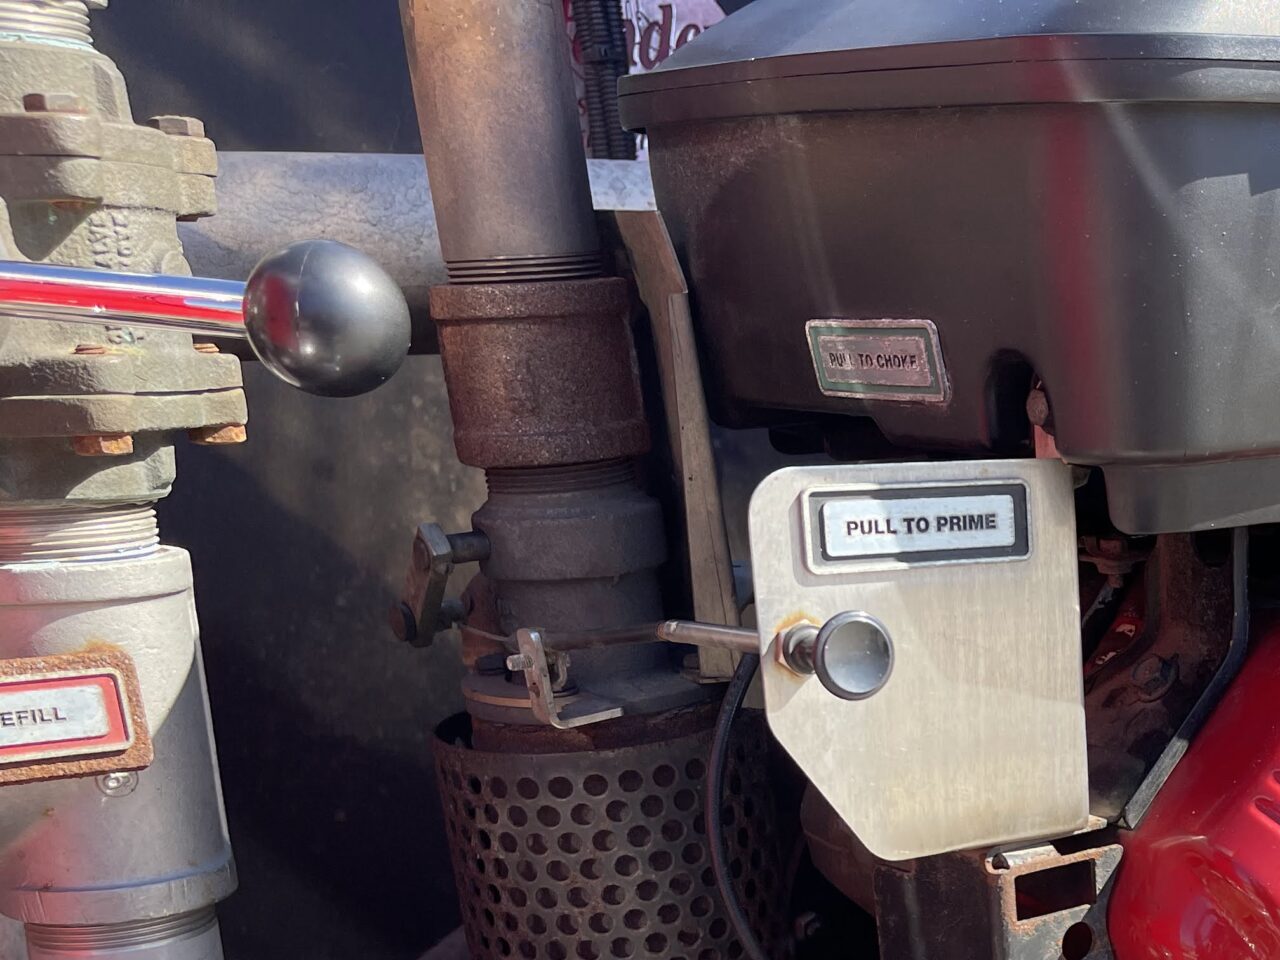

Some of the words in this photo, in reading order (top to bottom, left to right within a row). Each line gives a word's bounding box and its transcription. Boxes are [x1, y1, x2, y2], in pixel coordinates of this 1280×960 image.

[858, 353, 873, 367] TO
[876, 354, 917, 369] CHOKE
[846, 518, 897, 536] PULL
[903, 516, 930, 534] TO
[936, 513, 997, 533] PRIME
[0, 706, 67, 727] EFILL
